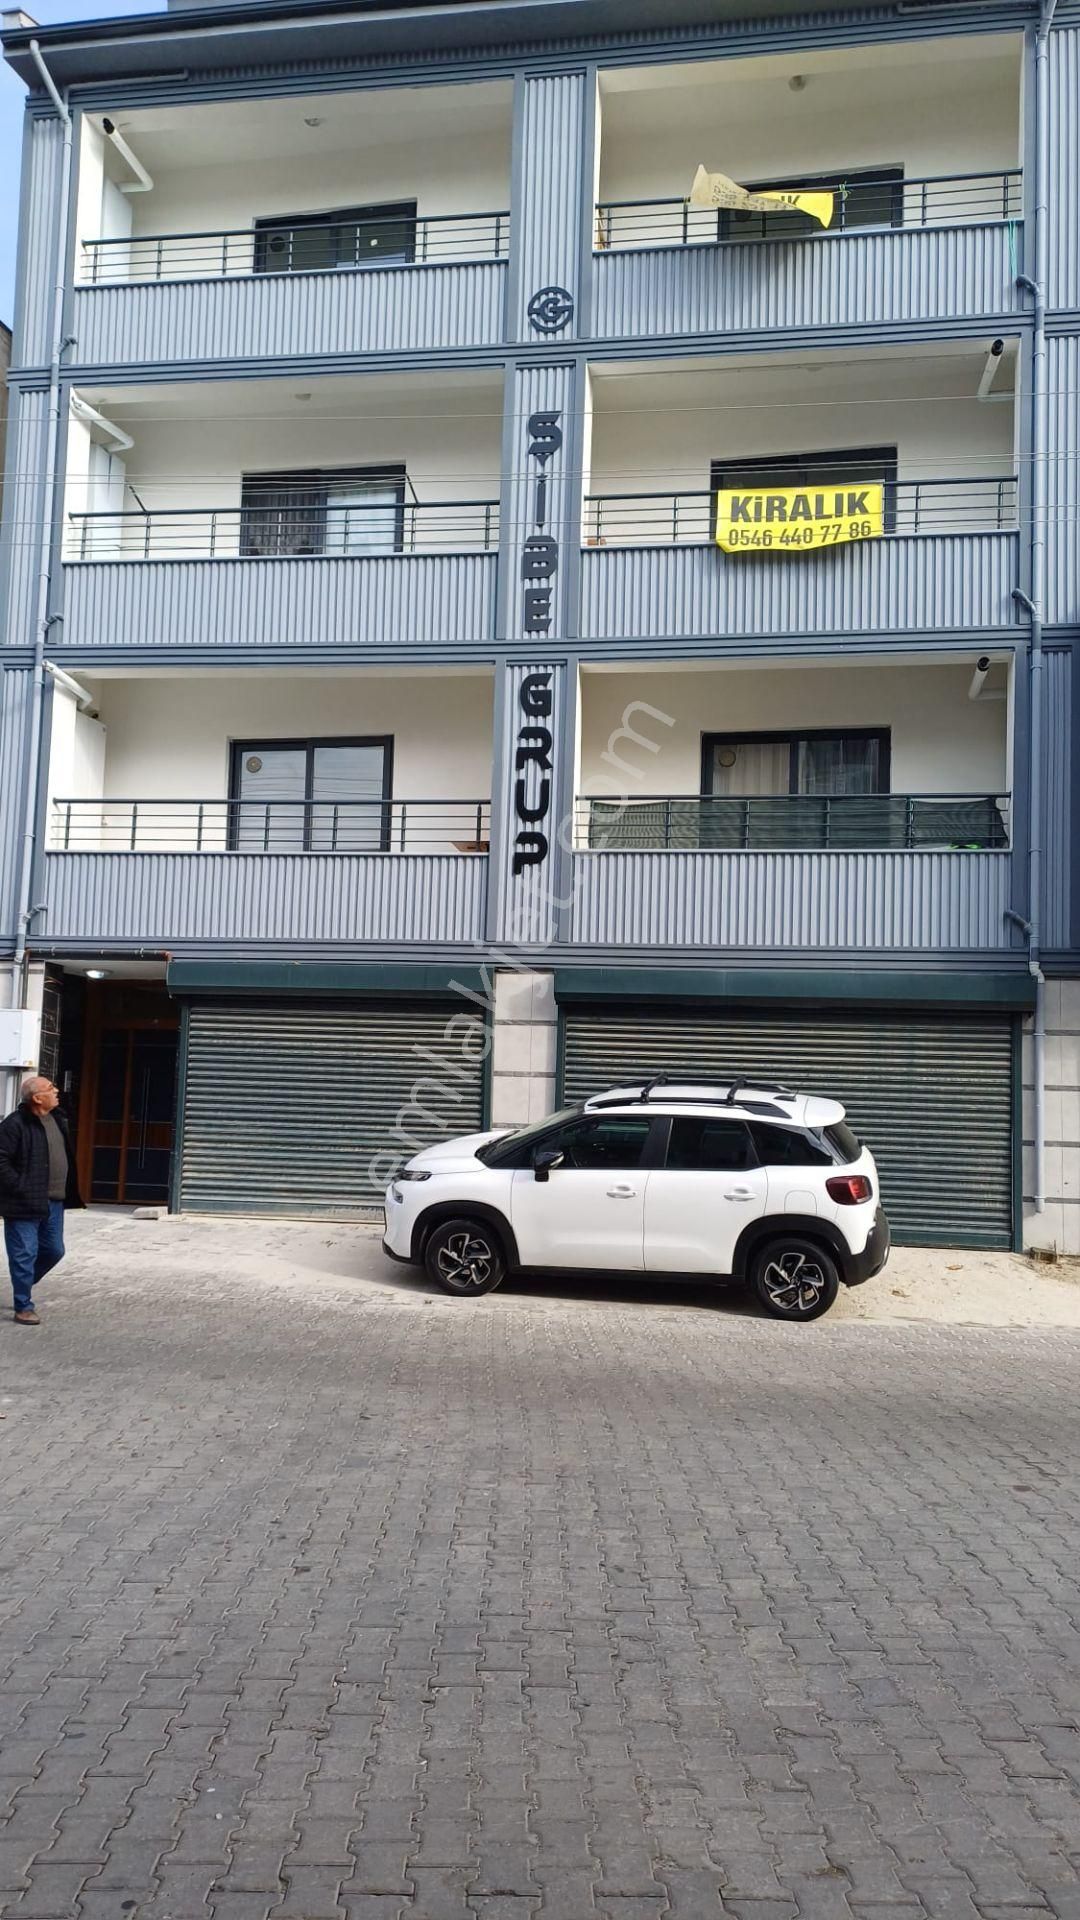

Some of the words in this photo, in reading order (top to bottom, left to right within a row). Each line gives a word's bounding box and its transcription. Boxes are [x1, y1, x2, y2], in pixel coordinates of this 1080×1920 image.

[728, 528, 774, 547] 0546
[779, 527, 813, 545] 440
[820, 523, 842, 543] 77
[849, 520, 872, 539] 86
[512, 672, 554, 876] GRUP
